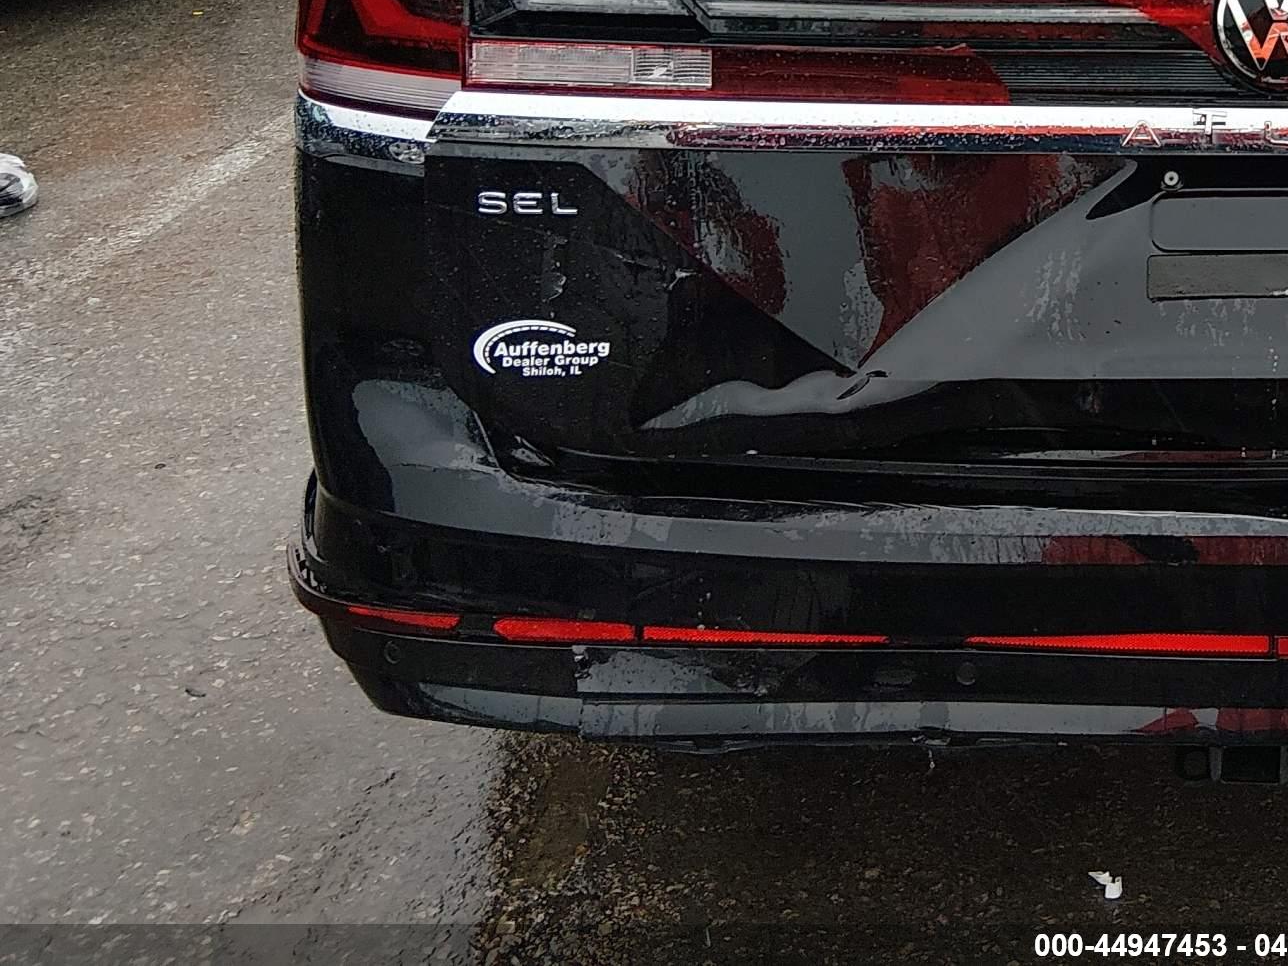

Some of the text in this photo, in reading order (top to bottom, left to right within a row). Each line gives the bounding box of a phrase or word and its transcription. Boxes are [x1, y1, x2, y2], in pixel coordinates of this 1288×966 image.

[477, 190, 578, 215] SEL
[493, 339, 611, 357] Auffenberg
[502, 355, 599, 368] Dealer Group
[522, 365, 583, 378] Shiloh, IL
